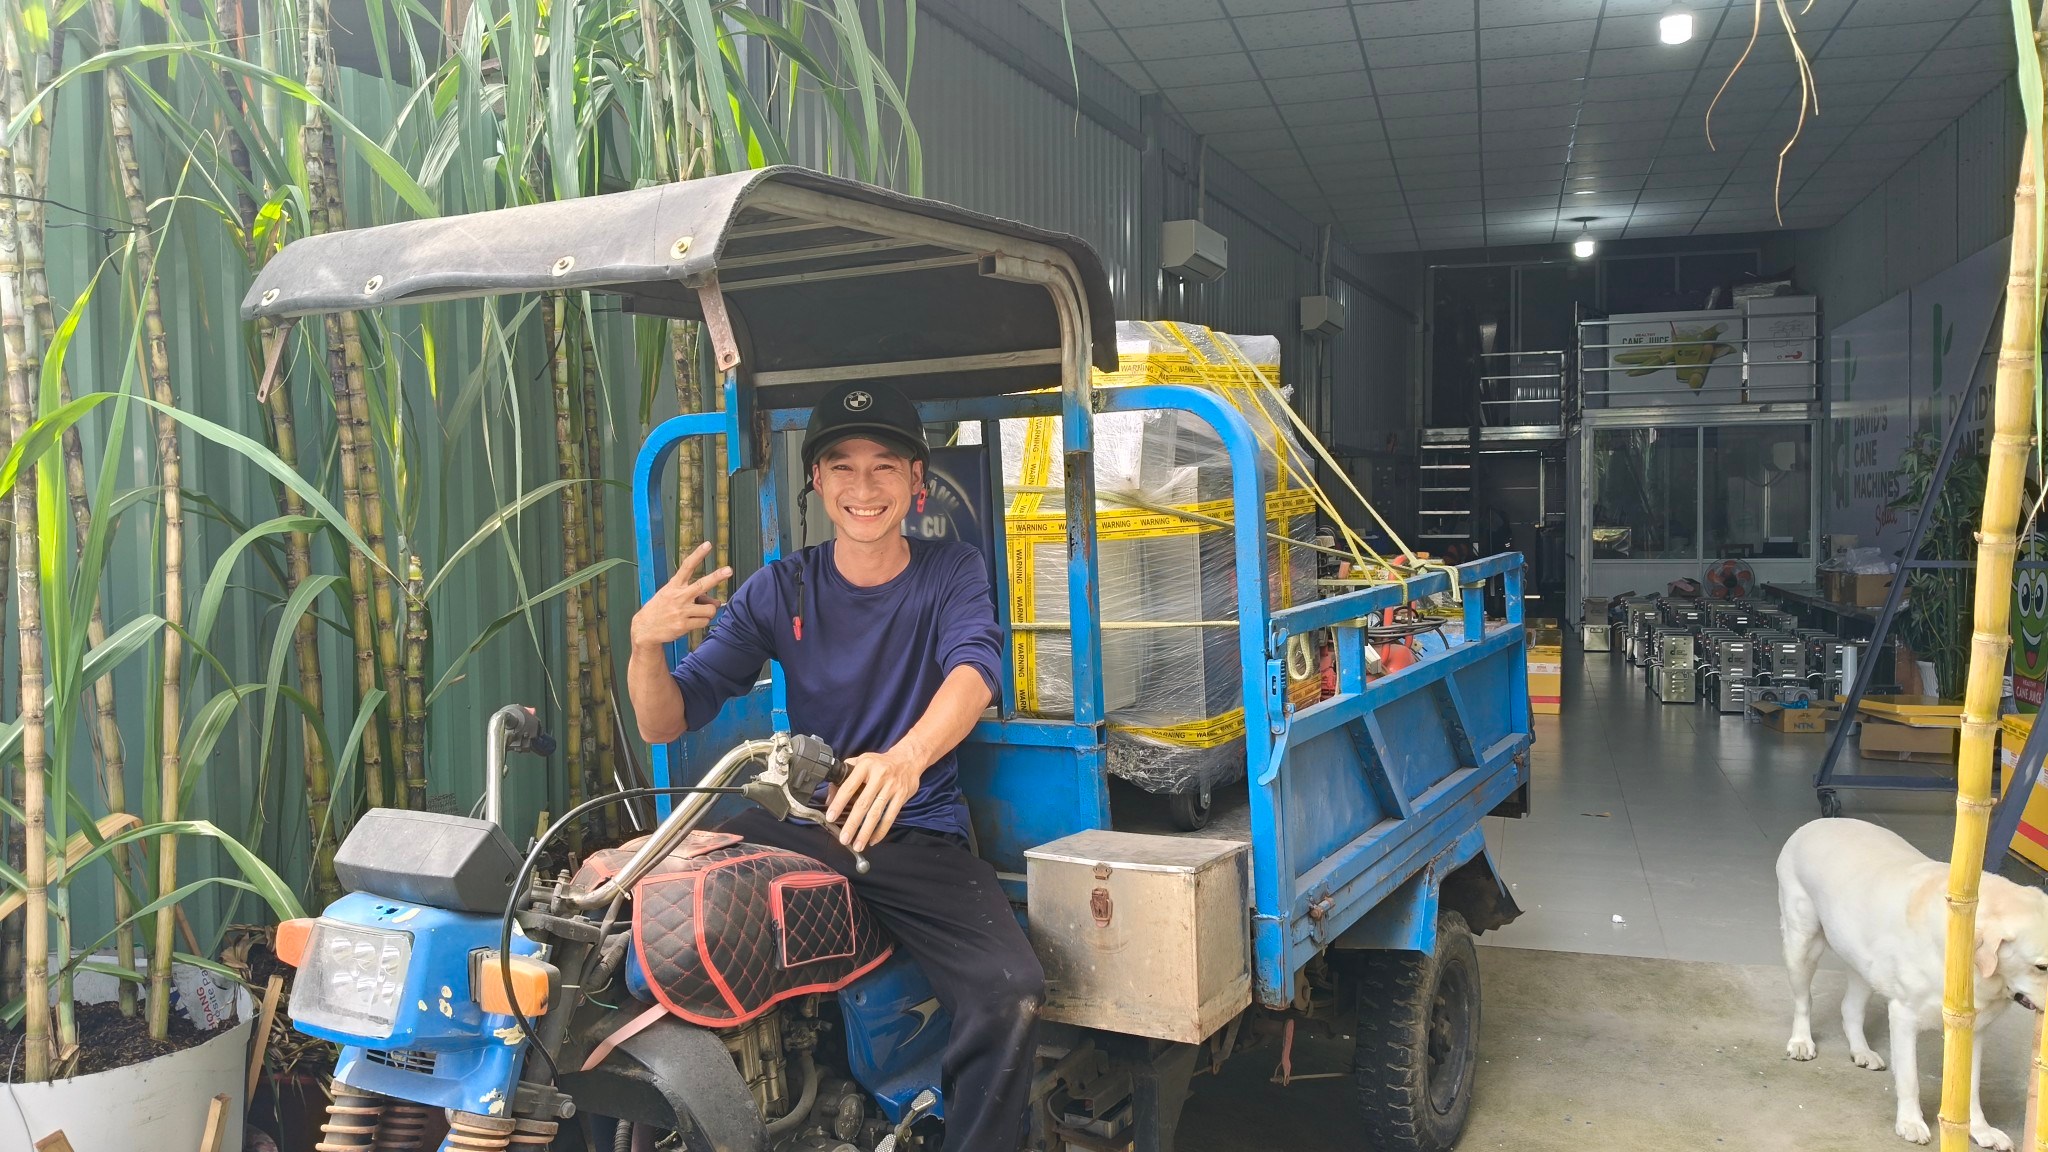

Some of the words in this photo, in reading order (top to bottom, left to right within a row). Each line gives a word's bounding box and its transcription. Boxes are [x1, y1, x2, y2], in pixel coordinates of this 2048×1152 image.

[1121, 364, 1154, 374] WARNING
[1853, 405, 1888, 438] DAVID'S
[1031, 417, 1044, 453] WARNING
[1854, 440, 1877, 468] CANE
[1854, 471, 1900, 499] MACHINES
[1101, 519, 1131, 530] WARNING
[1140, 517, 1170, 526] WARNING
[1019, 689, 1027, 710] WARN
[2015, 686, 2029, 700] CANE
[2028, 689, 2042, 704] JUICE
[202, 969, 211, 986] Pa
[208, 988, 221, 1019] osite
